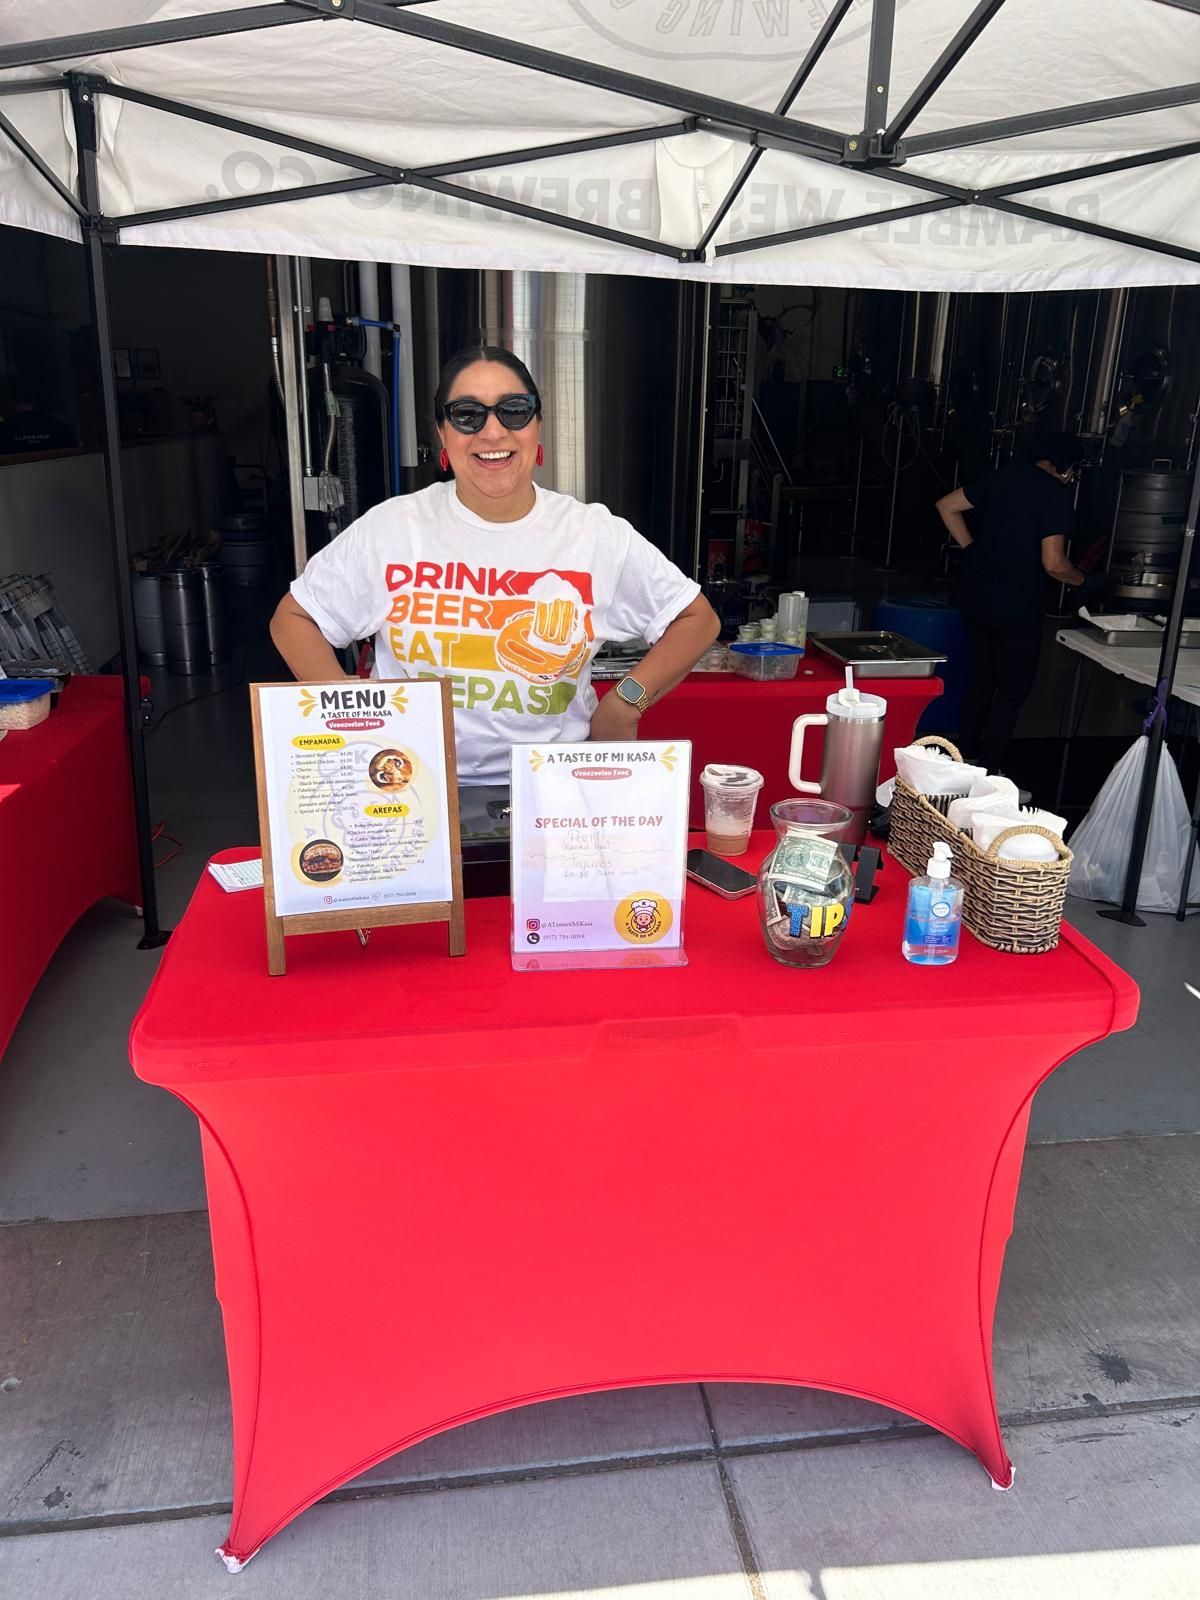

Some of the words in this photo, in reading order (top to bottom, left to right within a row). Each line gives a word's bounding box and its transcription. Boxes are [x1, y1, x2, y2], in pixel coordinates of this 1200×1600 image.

[385, 561, 517, 597] DRINK
[386, 591, 491, 629] BEER
[390, 626, 460, 667] EAT
[320, 688, 386, 710] MENU
[418, 672, 552, 716] EPAS
[328, 711, 350, 719] TASTE
[362, 710, 372, 718] MI
[299, 738, 341, 746] EMPANADAS
[547, 753, 555, 764] A
[557, 752, 592, 763] TASTE
[594, 752, 609, 763] OF
[611, 752, 624, 763] MI
[627, 751, 656, 762] KASA
[574, 769, 612, 777] Venezuelan
[372, 805, 402, 815] AREPAS
[534, 817, 589, 829] SPECIAL
[591, 816, 608, 828] OF
[610, 815, 636, 827] THE
[638, 815, 663, 827] DAY
